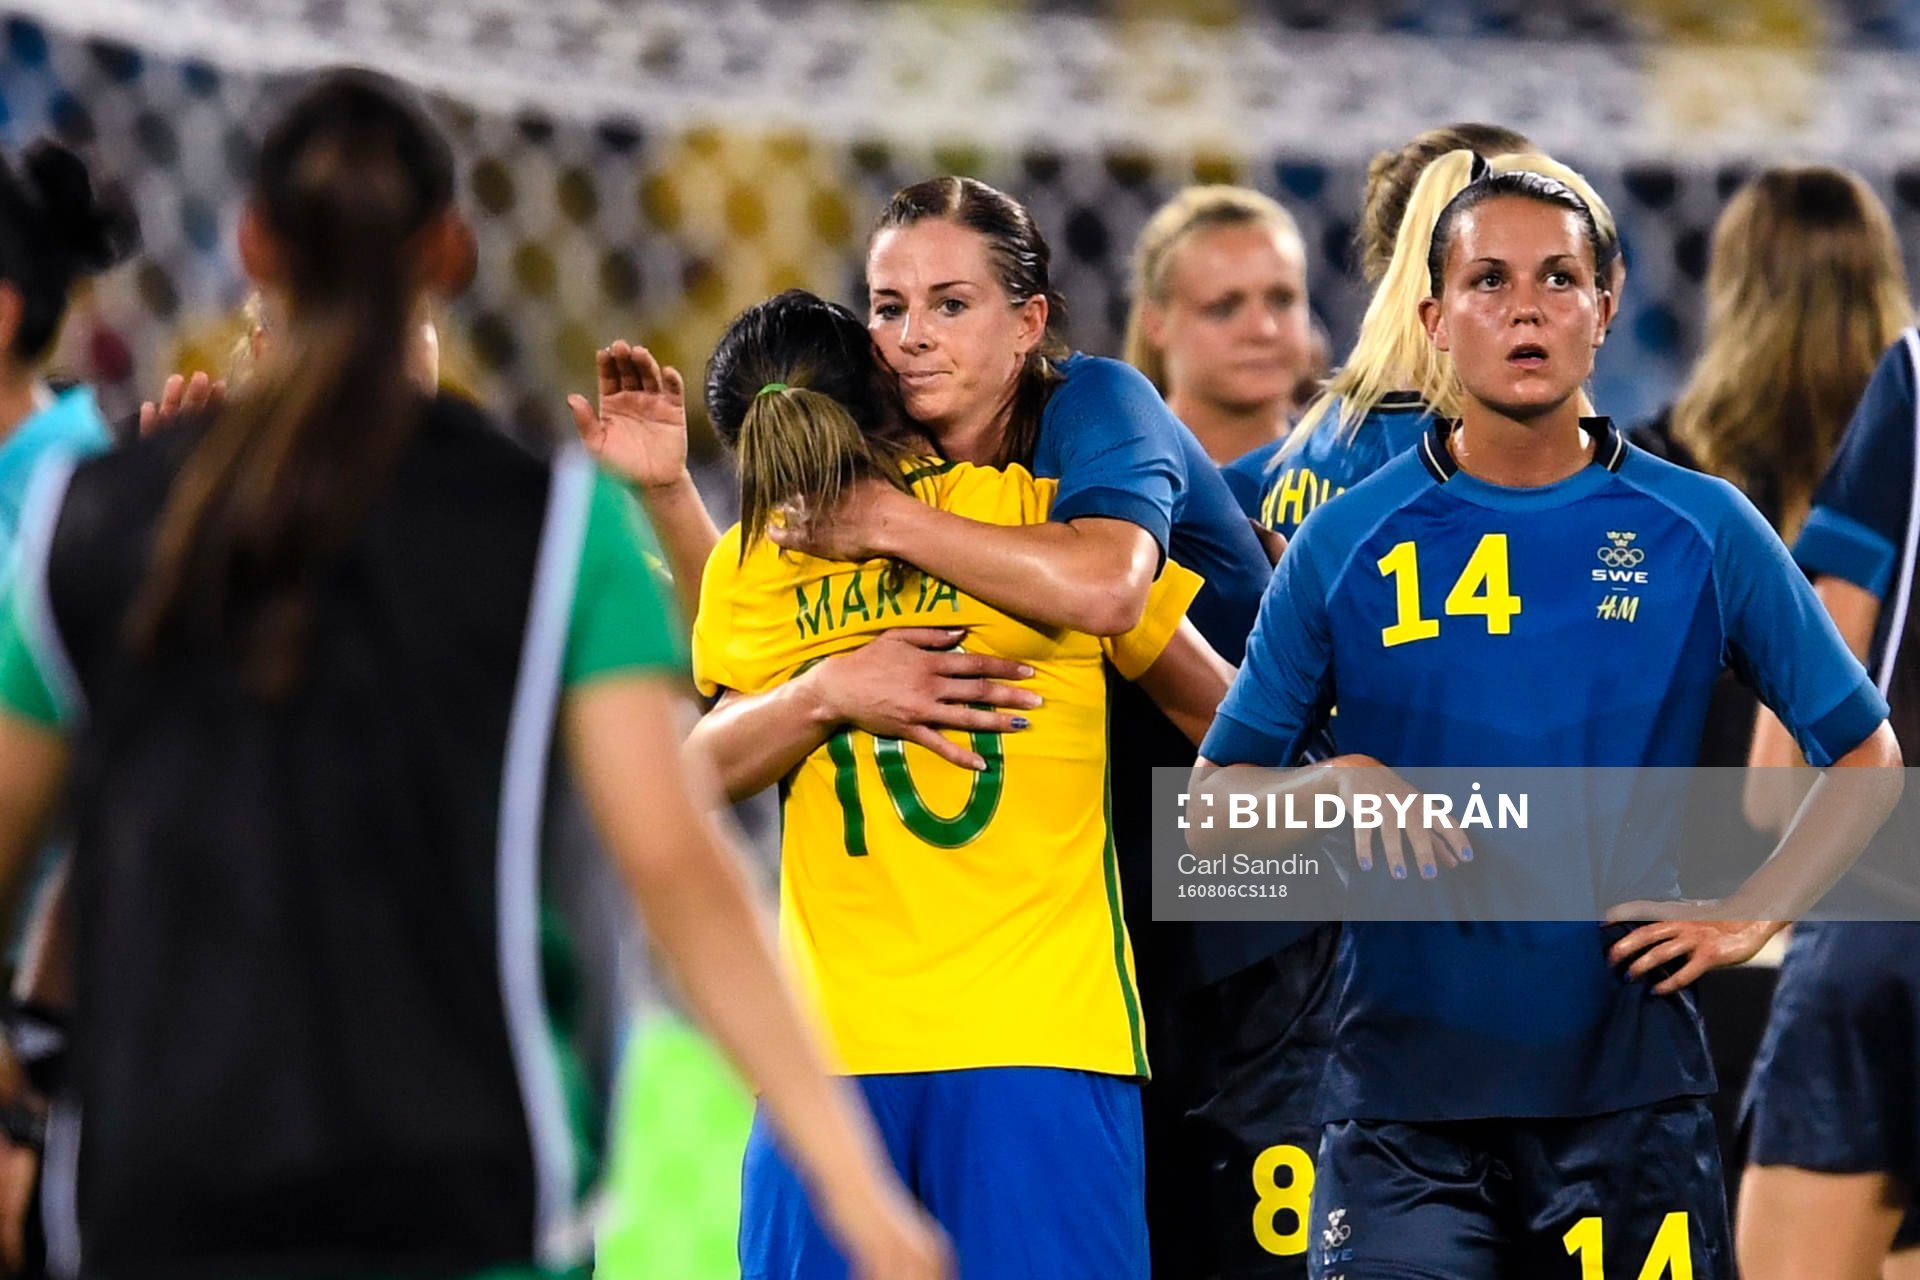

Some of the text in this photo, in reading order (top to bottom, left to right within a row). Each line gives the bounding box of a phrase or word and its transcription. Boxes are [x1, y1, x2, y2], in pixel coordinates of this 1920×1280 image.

[1377, 533, 1521, 647] 14
[1591, 569, 1649, 584] SWE
[1596, 595, 1640, 623] H&M
[1252, 1144, 1315, 1256] 8
[1562, 1211, 1693, 1280] 14
